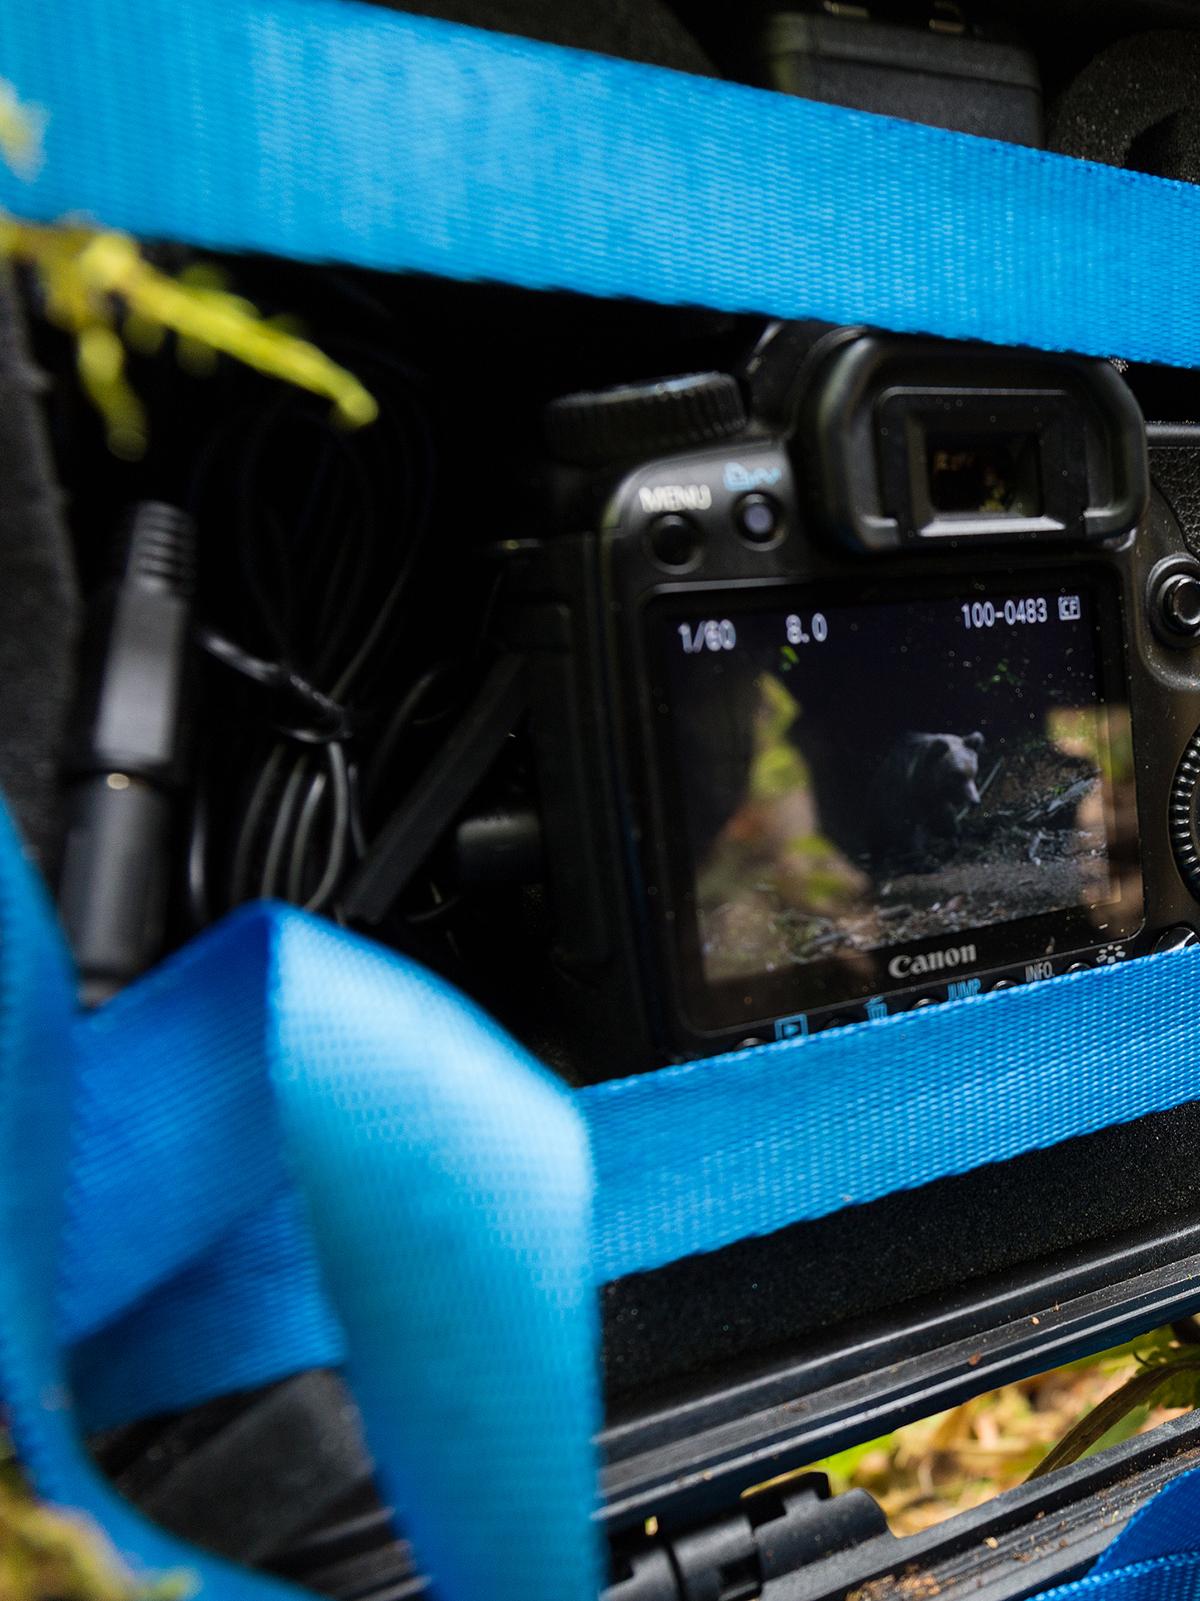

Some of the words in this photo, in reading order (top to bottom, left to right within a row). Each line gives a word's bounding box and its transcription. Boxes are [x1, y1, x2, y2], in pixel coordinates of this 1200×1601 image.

[638, 484, 713, 513] MENU
[785, 612, 828, 645] 8.0
[961, 597, 1049, 629] 100-0483
[1060, 599, 1078, 617] CF
[888, 943, 977, 979] Canon
[947, 978, 981, 1001] JUMP
